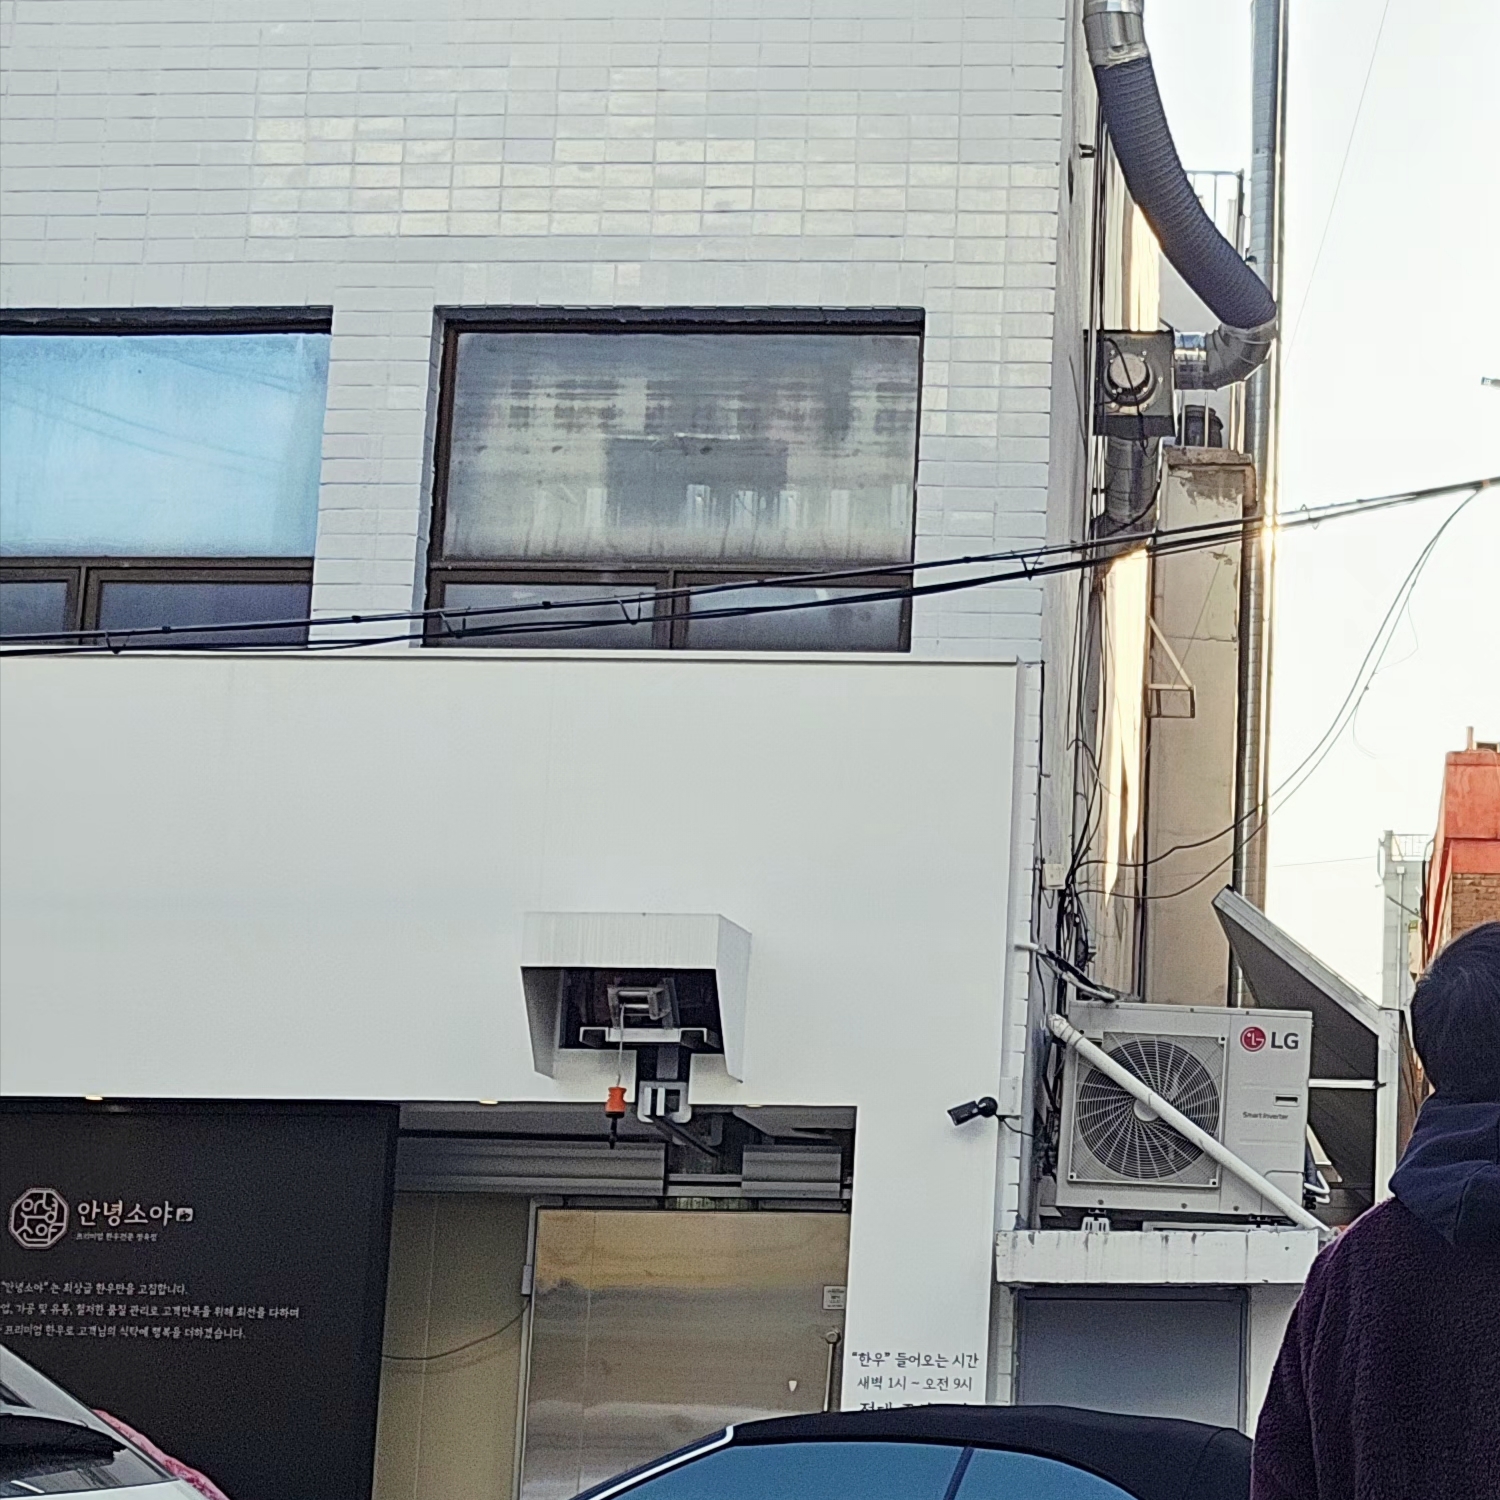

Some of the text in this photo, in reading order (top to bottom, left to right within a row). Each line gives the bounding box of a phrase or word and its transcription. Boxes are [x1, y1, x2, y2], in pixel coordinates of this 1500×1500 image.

[1271, 1031, 1299, 1049] LG
[78, 1200, 174, 1227] 안녕소야
[96, 1282, 136, 1295] 한우만을
[138, 1284, 188, 1296] 고집합니다.
[15, 1303, 35, 1315] 가공
[76, 1304, 104, 1316] 철저한
[129, 1305, 159, 1317] 관리로
[214, 1305, 234, 1318] 위해
[237, 1306, 266, 1319] 최선을
[268, 1306, 300, 1319] 다하며
[4, 1324, 246, 1340] 프리미엄 한우로 고객님의 식탁에 행복을 더하겠습니다.
[895, 1352, 949, 1368] 들어오는
[952, 1353, 979, 1369] 시간
[857, 1376, 883, 1390] 새벽
[888, 1376, 906, 1391] 1시
[922, 1376, 949, 1392] 오전
[953, 1377, 972, 1392] 9시
